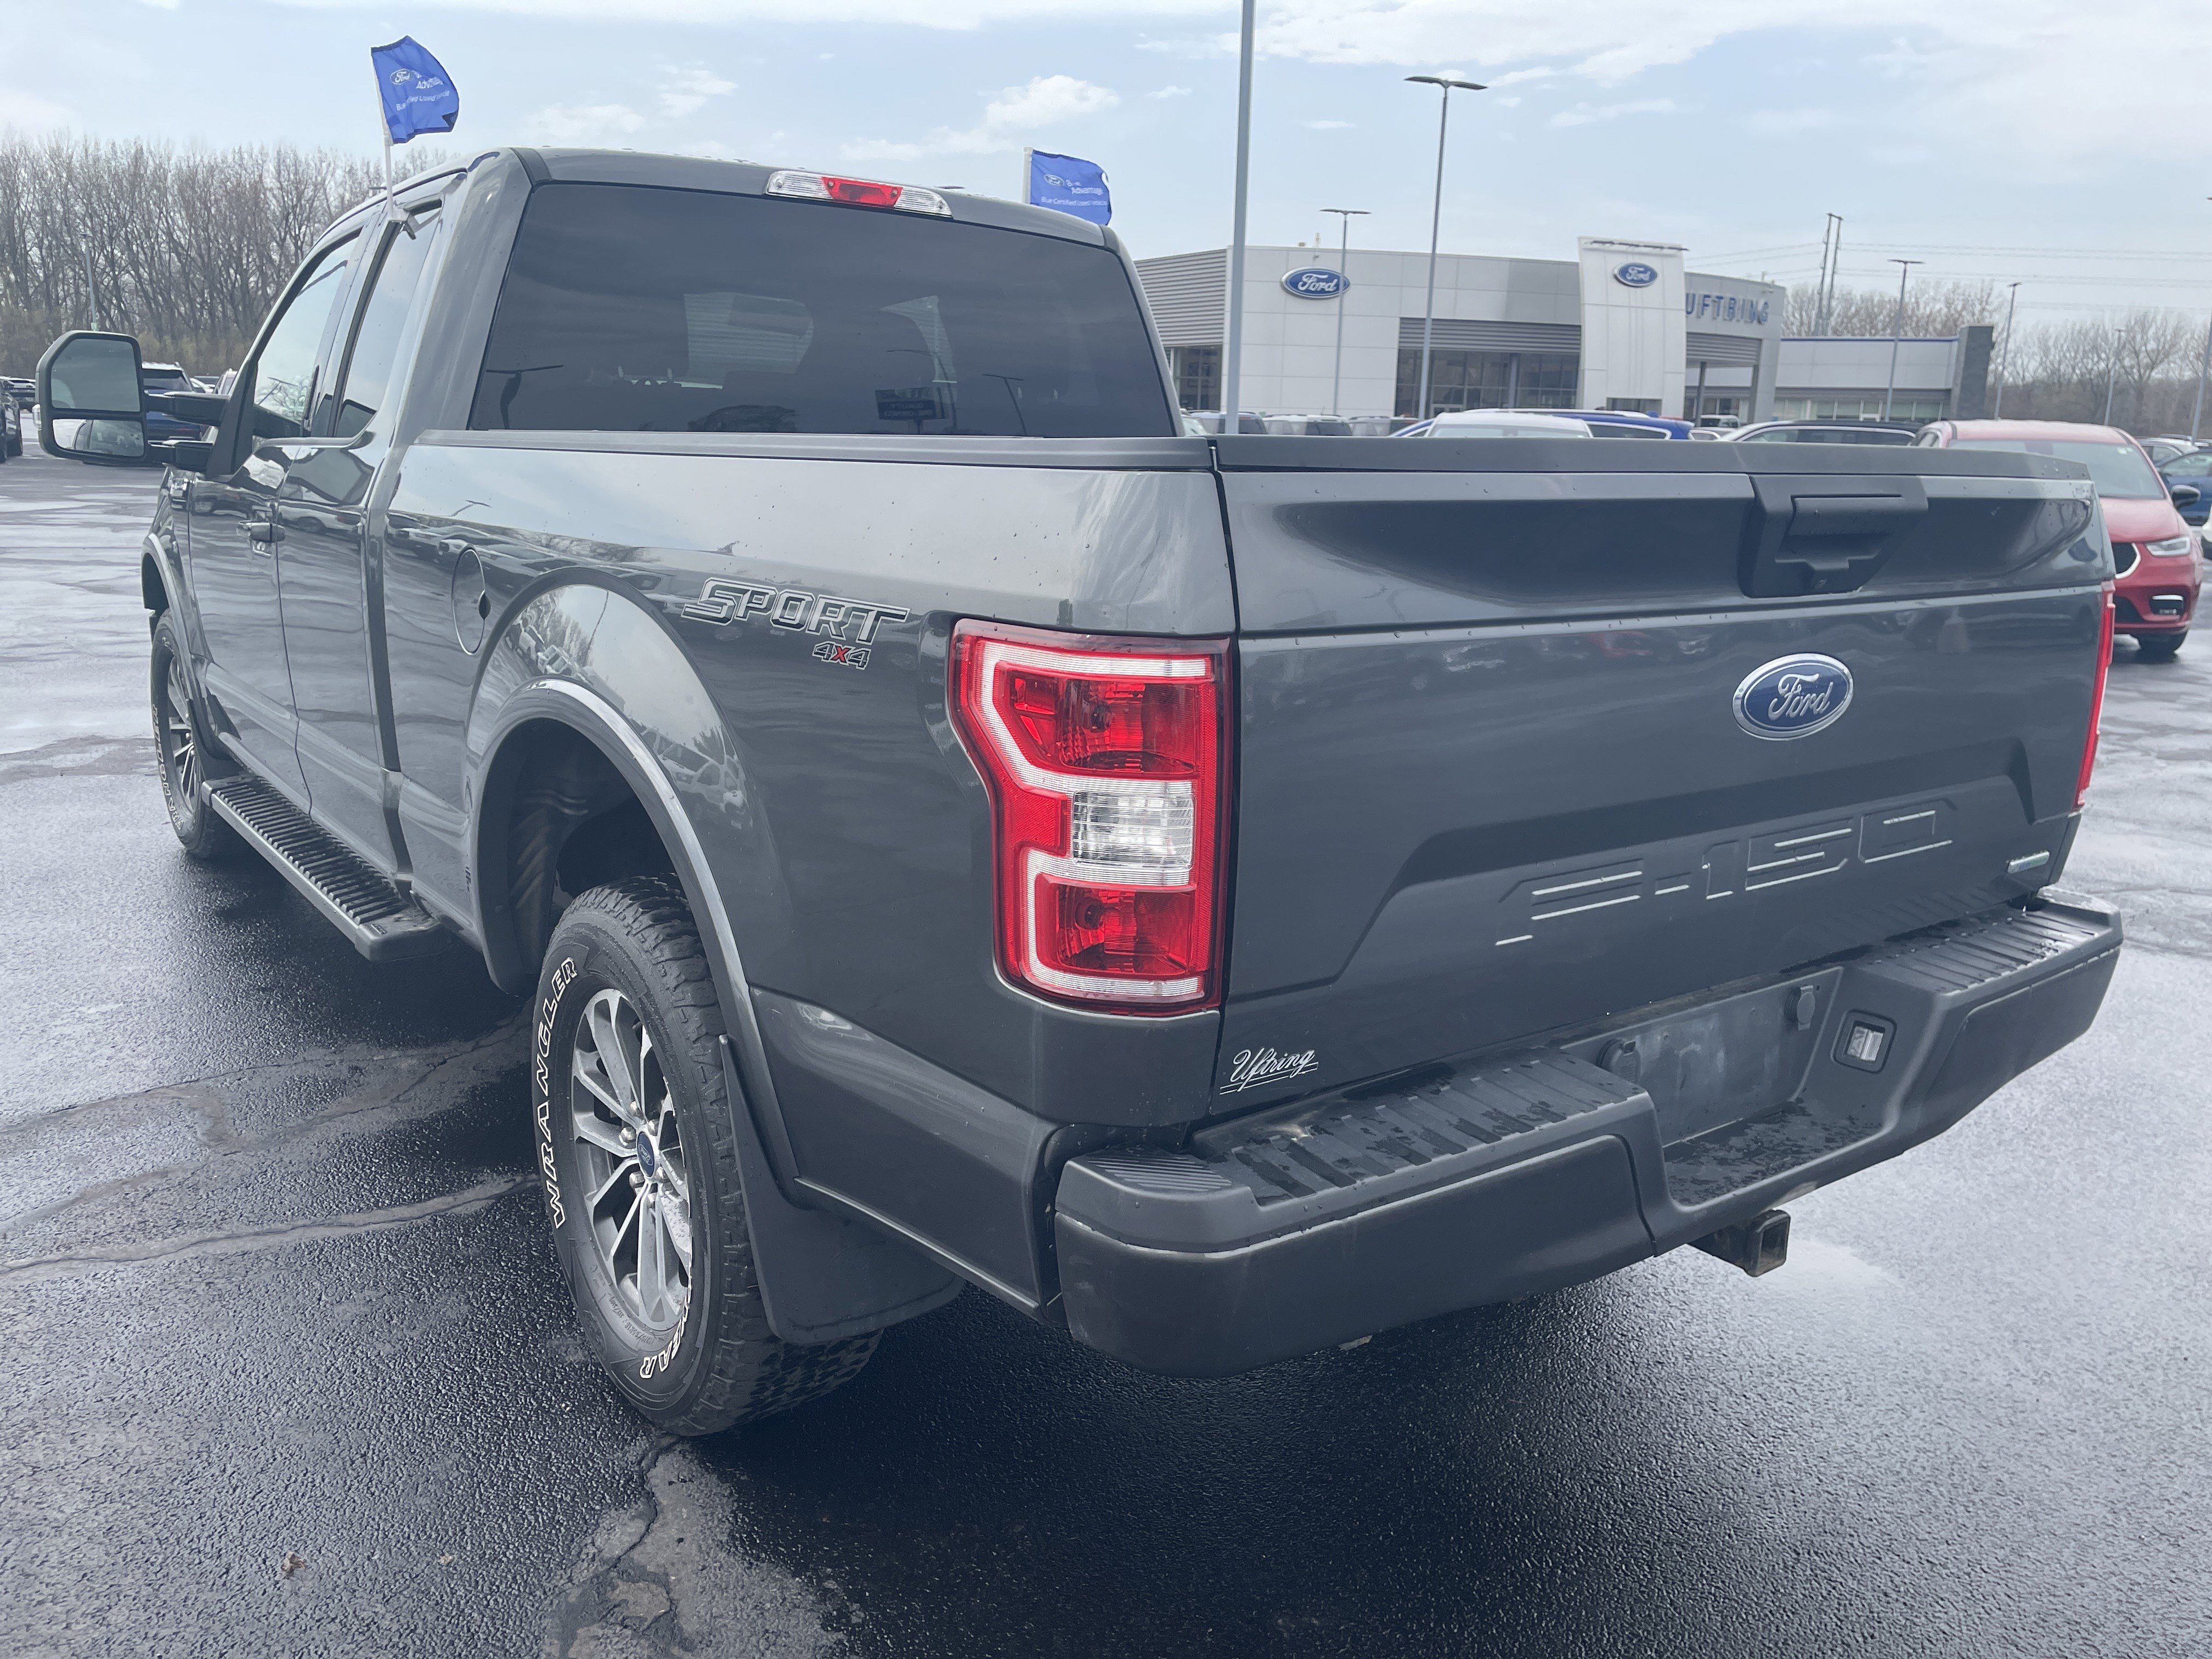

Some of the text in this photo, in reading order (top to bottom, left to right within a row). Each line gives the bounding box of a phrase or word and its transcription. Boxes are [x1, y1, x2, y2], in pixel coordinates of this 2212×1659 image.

[1297, 273, 1338, 291] Ford
[1626, 266, 1651, 281] Ford
[681, 577, 911, 646] SPORT
[1768, 673, 1833, 721] Ford
[1496, 798, 1957, 946] F-150
[536, 957, 578, 1229] WRANGLER
